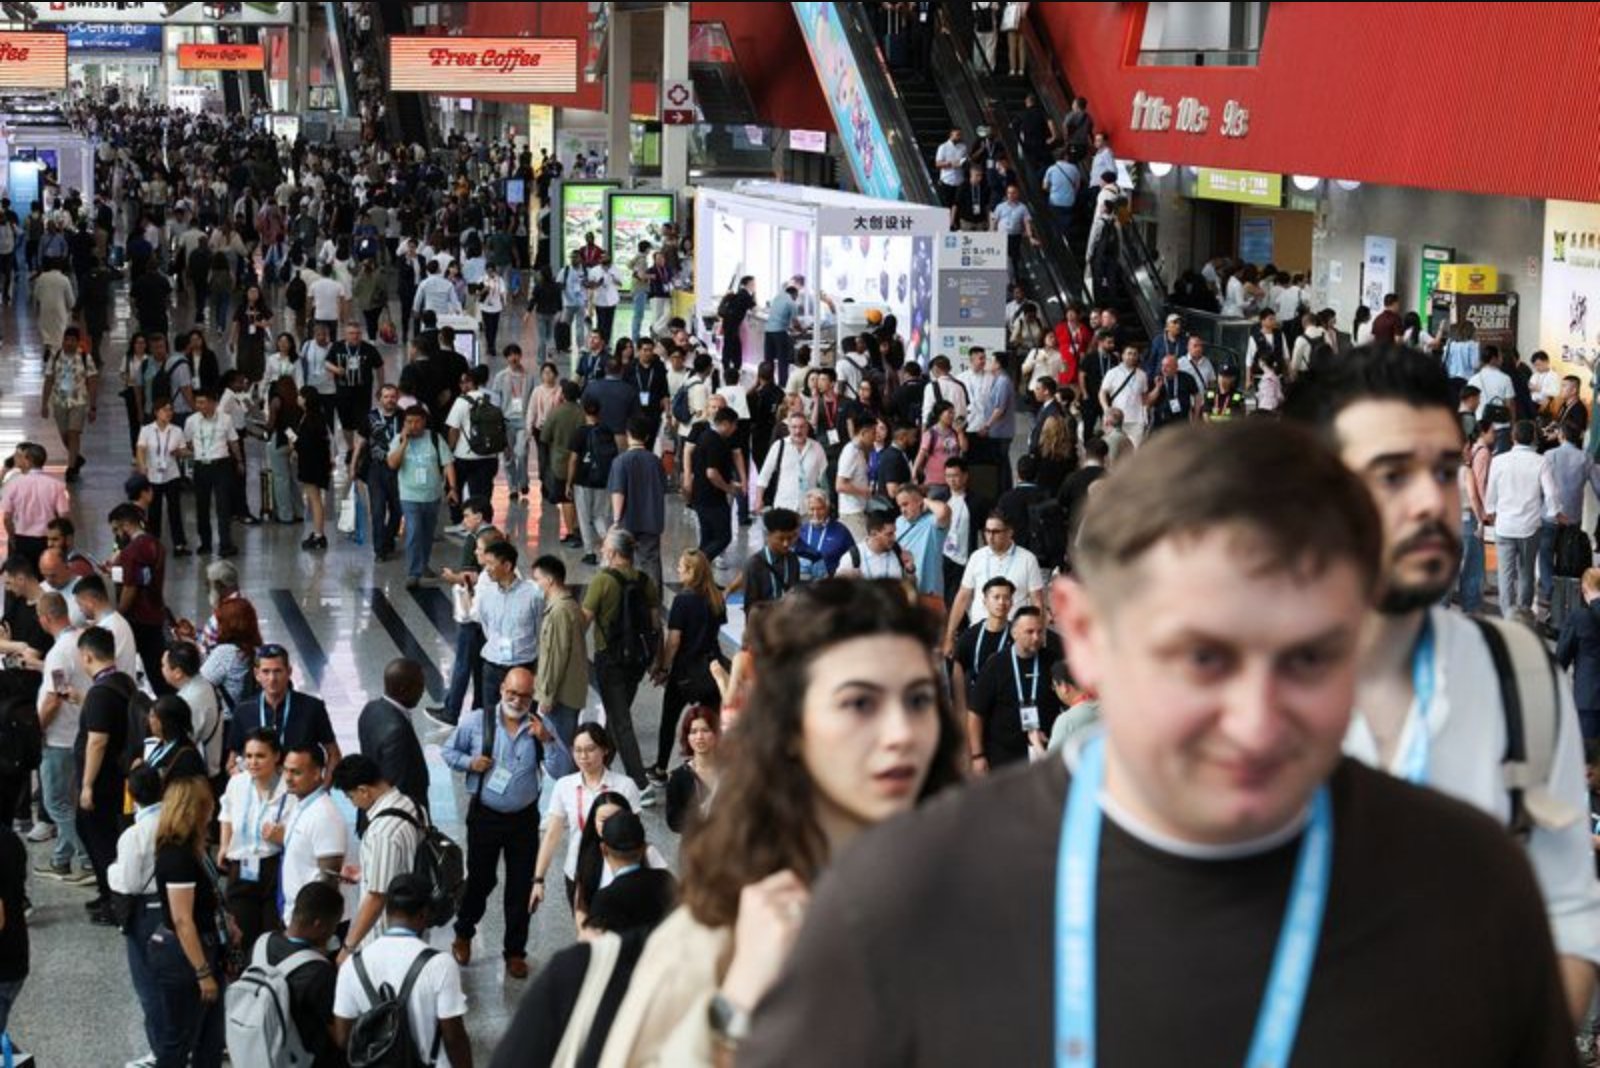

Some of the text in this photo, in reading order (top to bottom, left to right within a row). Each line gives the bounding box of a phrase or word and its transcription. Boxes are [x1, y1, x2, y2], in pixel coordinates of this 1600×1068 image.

[0, 42, 30, 61] fee
[428, 48, 541, 73] Free Coffee
[853, 215, 915, 231] 大创设计
